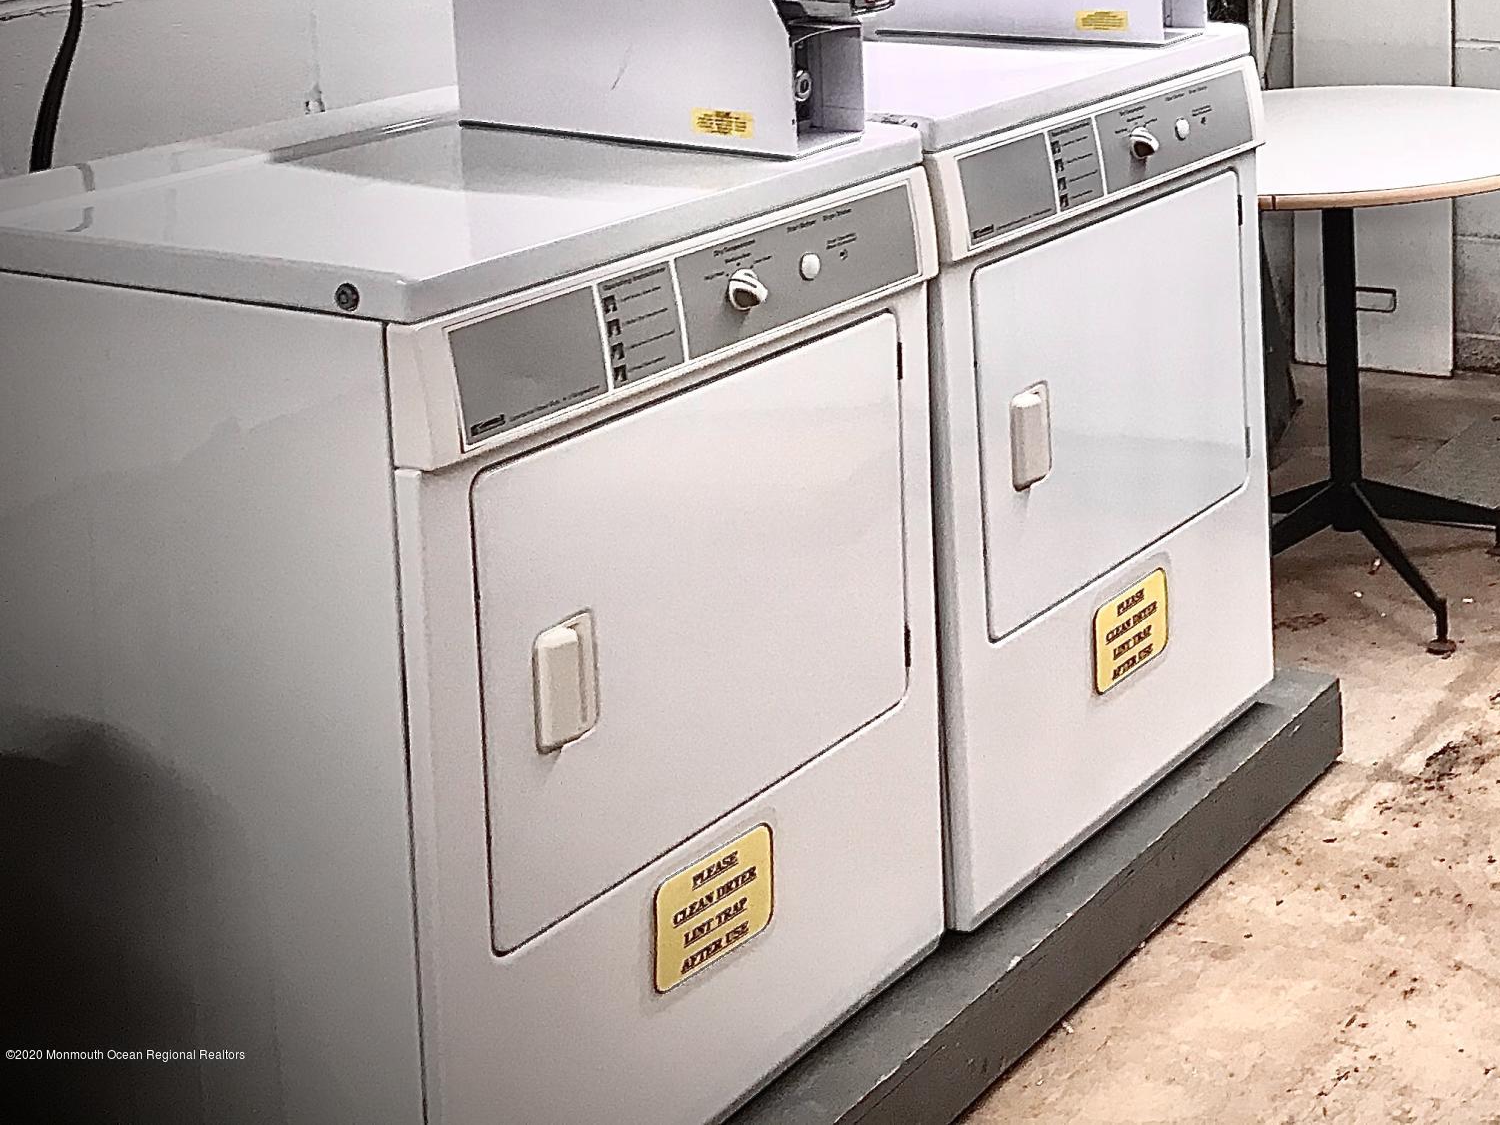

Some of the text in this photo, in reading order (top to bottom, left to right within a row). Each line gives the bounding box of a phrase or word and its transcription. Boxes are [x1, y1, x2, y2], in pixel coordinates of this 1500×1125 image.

[692, 850, 739, 889] PLEASE
[673, 866, 757, 926] CLEAN DRYER
[684, 897, 748, 947] LINT TRAP
[681, 920, 750, 974] AFTER USE
